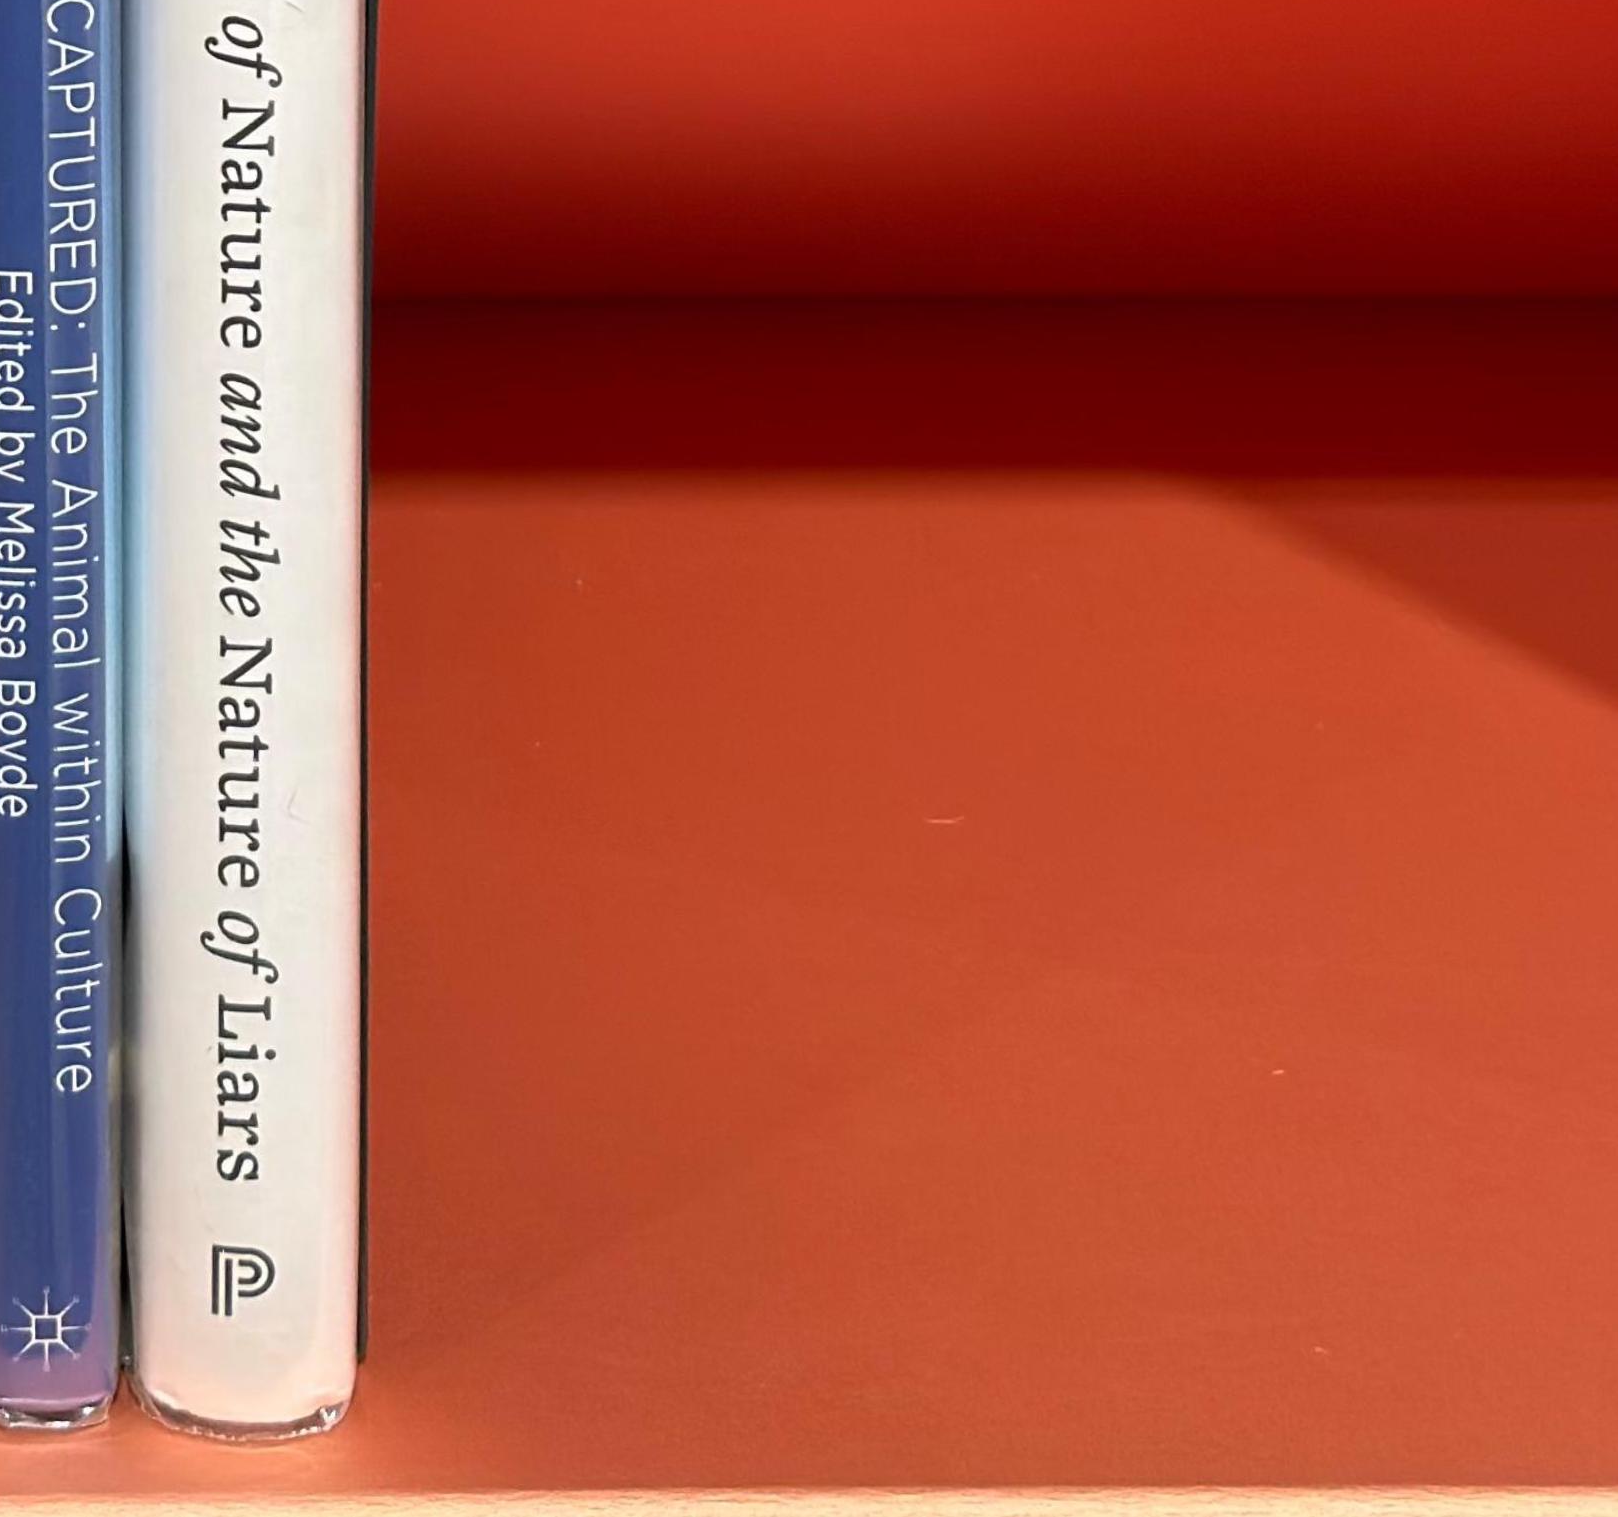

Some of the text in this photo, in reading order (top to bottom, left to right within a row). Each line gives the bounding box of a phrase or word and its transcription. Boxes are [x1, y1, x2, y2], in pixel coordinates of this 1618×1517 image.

[204, 16, 283, 89] of
[218, 96, 277, 349] Nature
[49, 352, 100, 456] The
[218, 372, 282, 501] and
[50, 479, 102, 670] Animal
[218, 518, 282, 618] the
[51, 691, 102, 864] within
[217, 635, 275, 889] Nature
[52, 887, 102, 1094] Culture
[200, 908, 280, 985] of
[215, 991, 278, 1184] Liars
